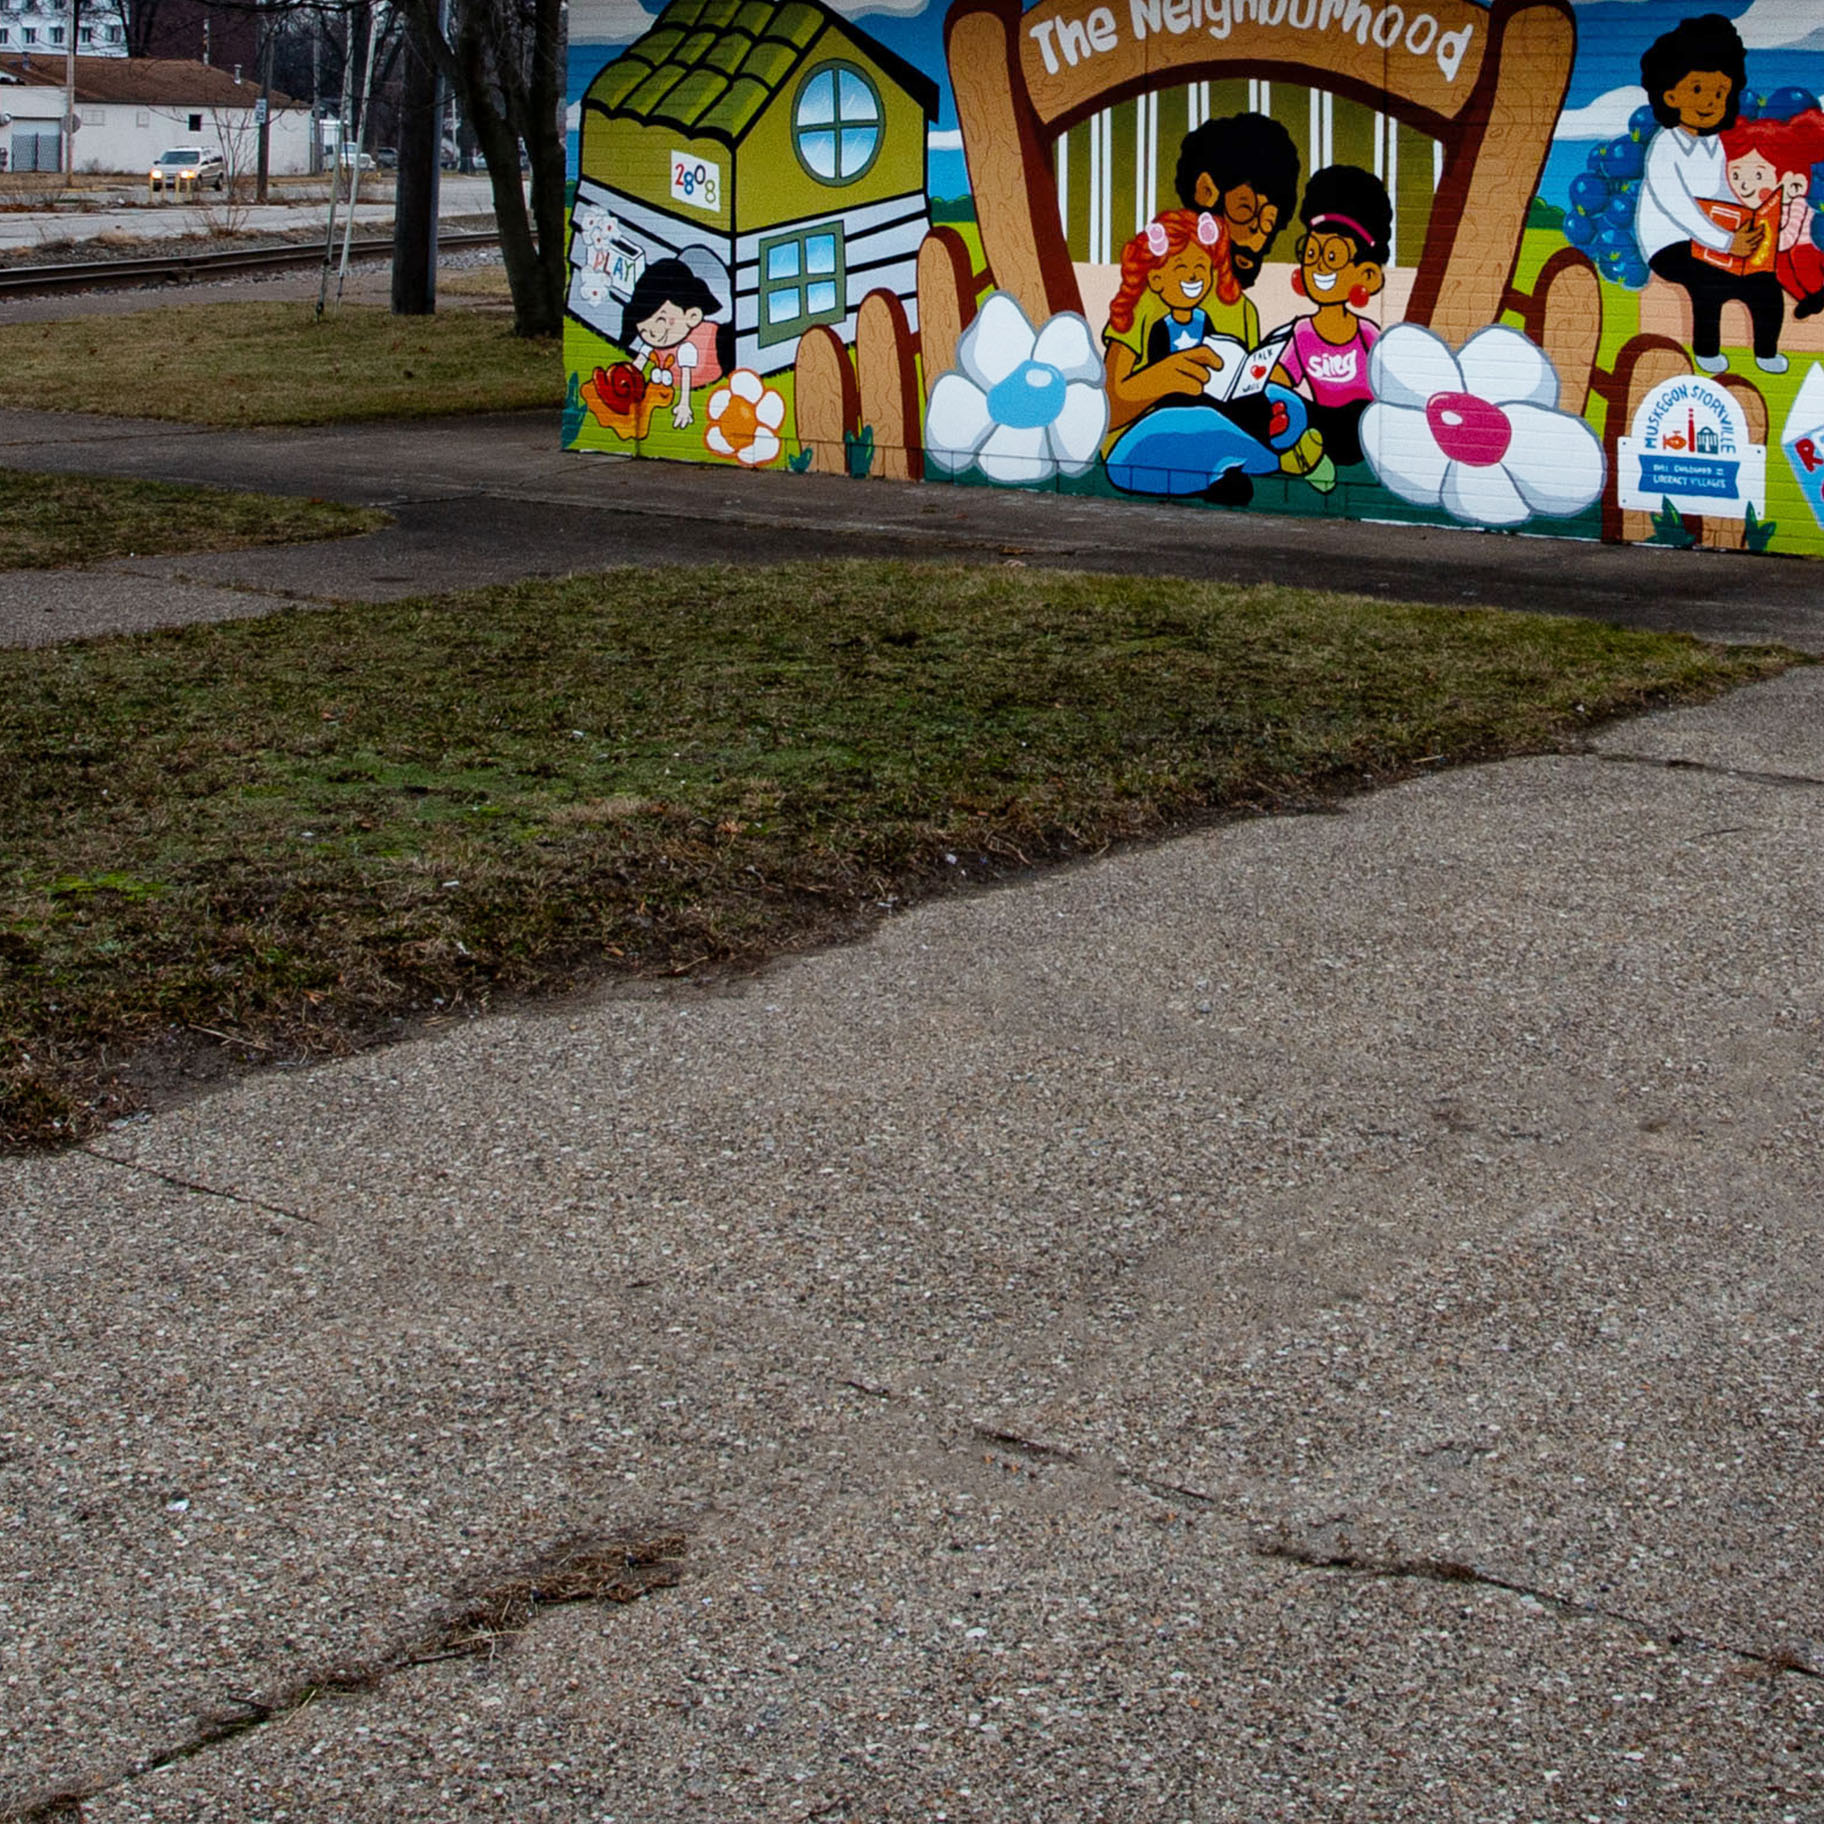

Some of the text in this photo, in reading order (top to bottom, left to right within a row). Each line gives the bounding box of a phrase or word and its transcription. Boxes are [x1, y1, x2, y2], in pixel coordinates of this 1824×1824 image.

[1029, 6, 1119, 75] The
[675, 163, 717, 204] 2808
[593, 248, 635, 283] PLAY
[1645, 384, 1736, 454] MUSKEGON STORYVILLE
